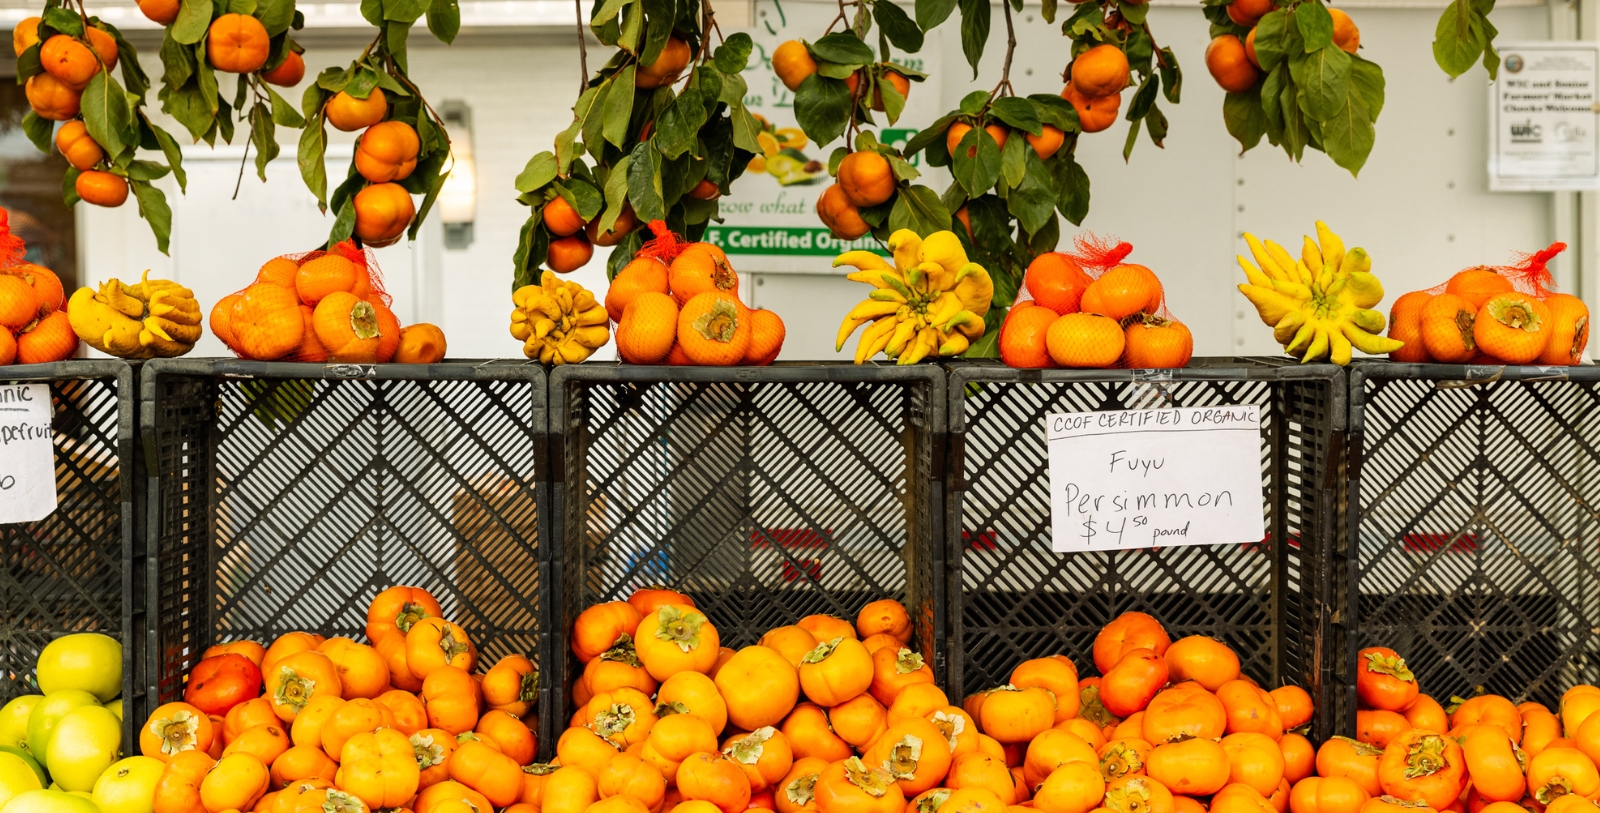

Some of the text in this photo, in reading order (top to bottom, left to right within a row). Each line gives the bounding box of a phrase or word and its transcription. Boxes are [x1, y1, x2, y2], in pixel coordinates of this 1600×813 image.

[719, 201, 754, 214] row
[760, 190, 807, 215] what
[727, 229, 813, 249] Certified
[0, 386, 33, 403] nic
[1053, 409, 1259, 433] CCOF CERTIFIED ORGANIC
[0, 422, 52, 446] pefruit
[1110, 450, 1165, 477] Fuyu
[1065, 483, 1232, 516] Persimmon
[1152, 521, 1191, 546] pound
